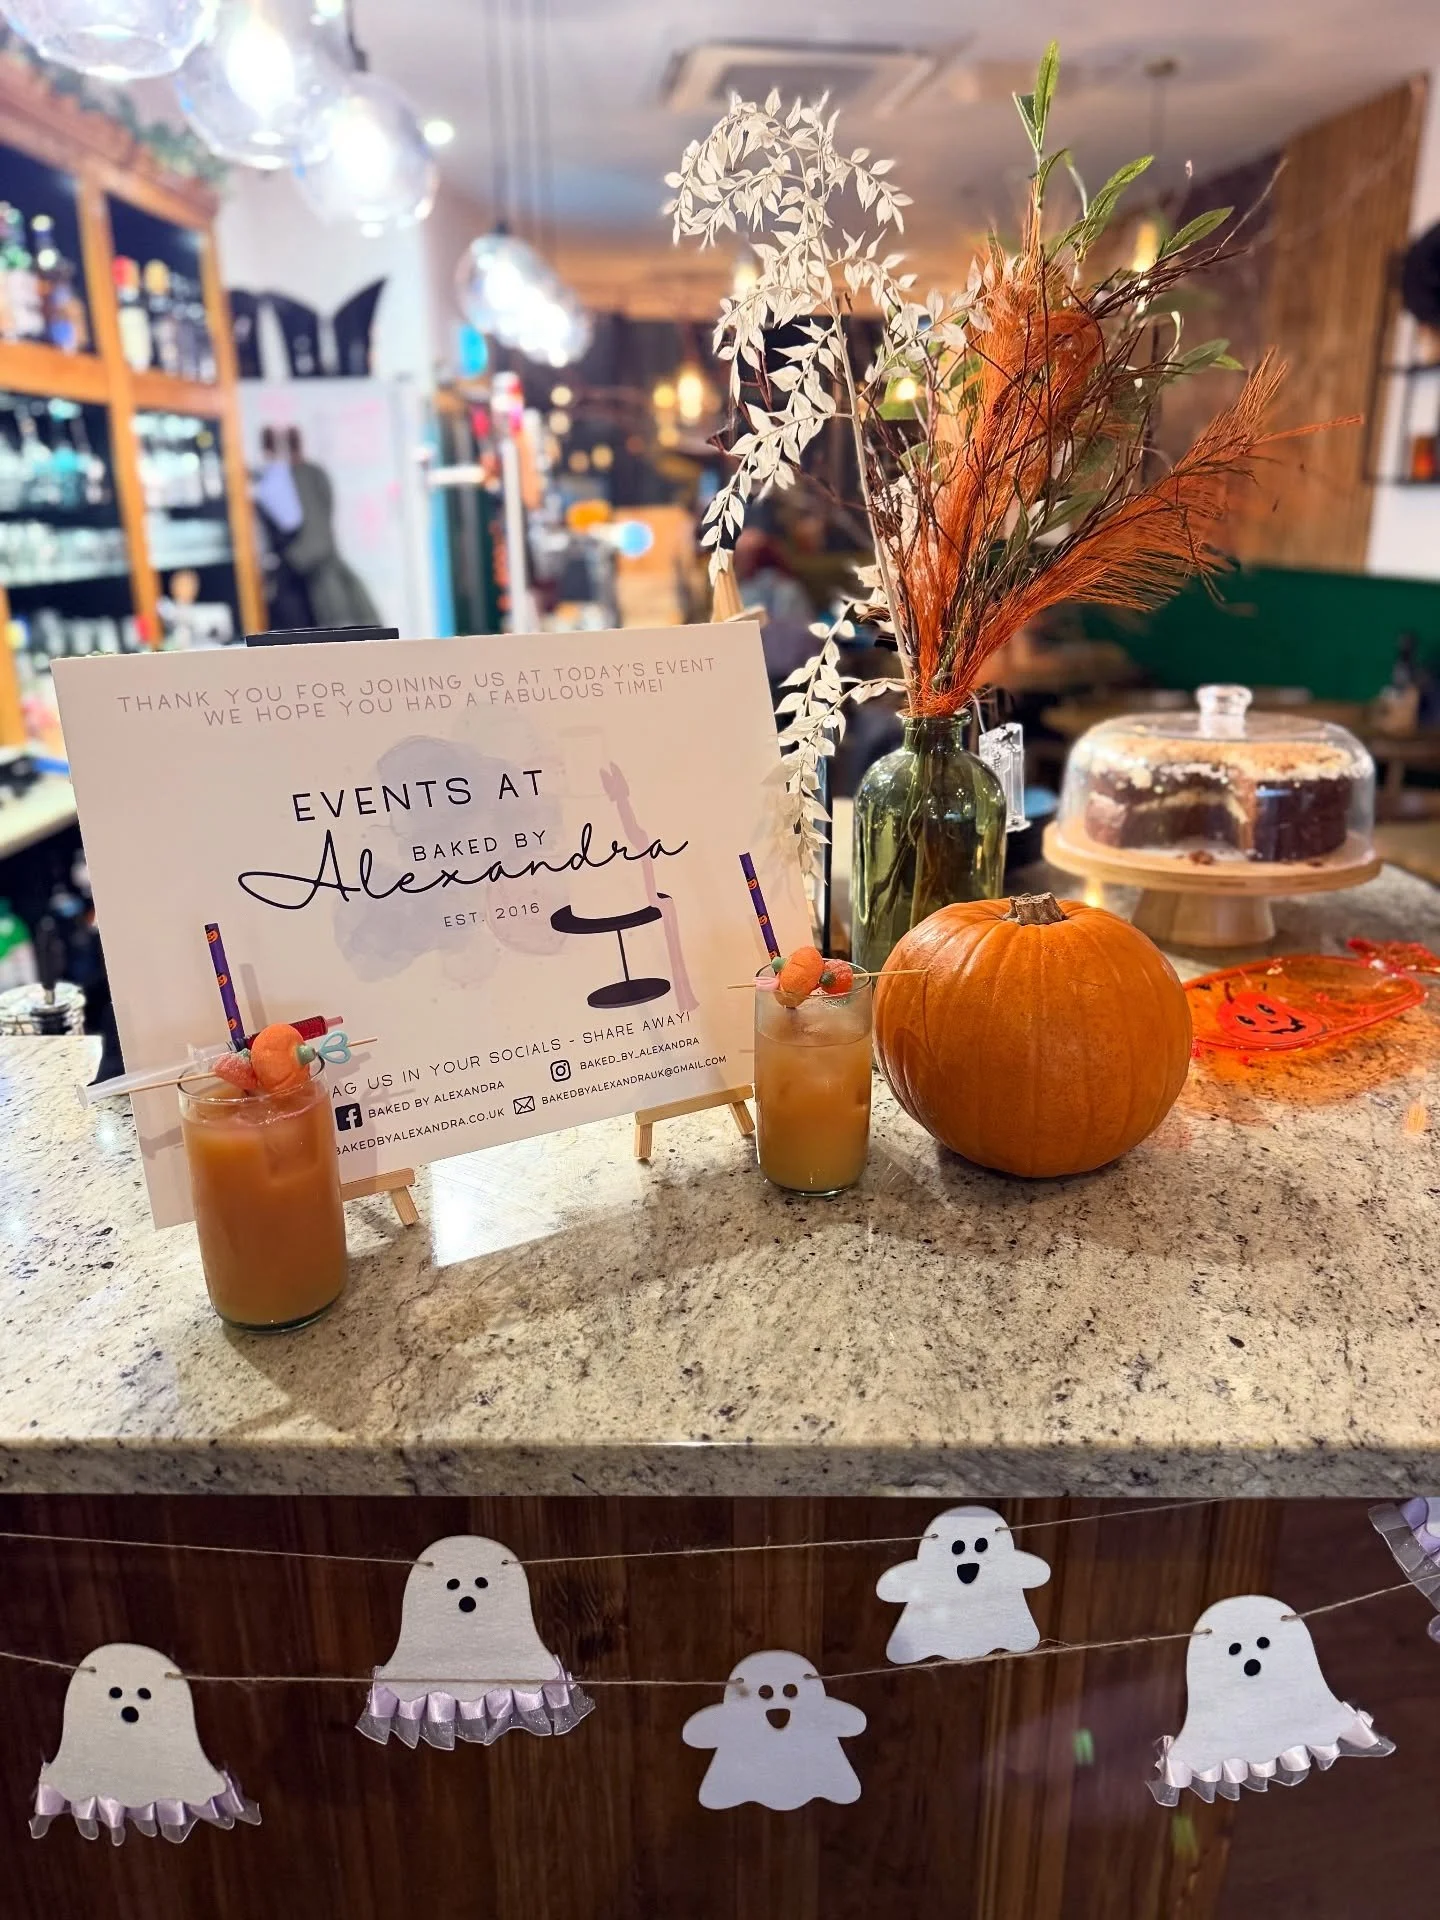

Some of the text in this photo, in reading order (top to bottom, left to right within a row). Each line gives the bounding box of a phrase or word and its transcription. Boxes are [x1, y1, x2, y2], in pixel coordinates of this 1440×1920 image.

[117, 657, 715, 713] THANK YOU FOR JOINING US AT TODAY'S EVENT
[203, 708, 243, 727] WE
[256, 702, 326, 722] HOPE
[339, 697, 393, 717] YOU
[406, 694, 452, 712] HAD
[466, 691, 478, 707] A
[489, 682, 604, 705] FABULOUS
[292, 770, 543, 822] EVENTS AT
[237, 822, 689, 910] Alexandra
[412, 829, 548, 862] BAKED BY
[443, 902, 541, 928] EST. 2016
[331, 1082, 358, 1099] AG
[367, 1074, 394, 1090] US
[402, 1068, 421, 1084] IN
[429, 1055, 482, 1077] YOUR
[488, 1038, 562, 1064] SOCIALS
[582, 1022, 635, 1044] SHARE
[580, 1036, 700, 1071] BAKED_BY_ALEXANDRA
[368, 1101, 411, 1119] BAKED
[415, 1096, 430, 1109] BY
[434, 1080, 506, 1105] ALEXANDRA
[541, 1055, 727, 1105] BAKEDBYALEXANDRAUK@GMAIL.COM
